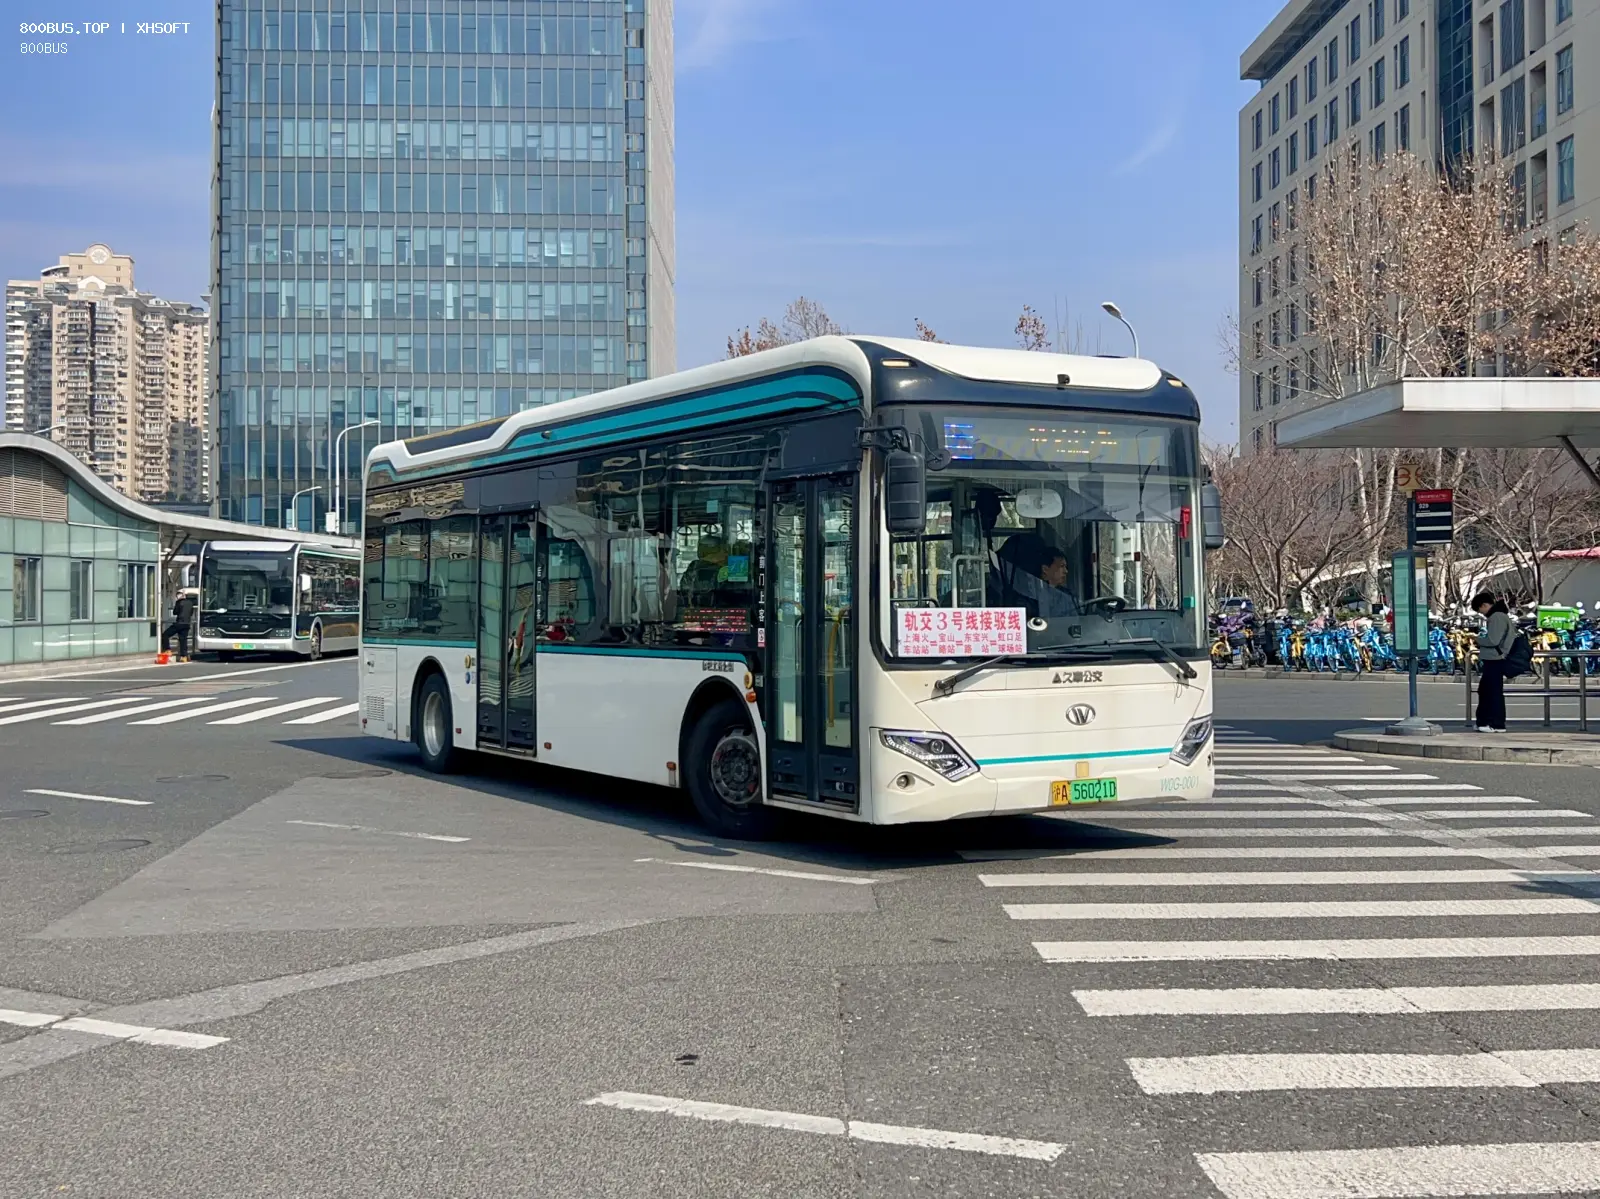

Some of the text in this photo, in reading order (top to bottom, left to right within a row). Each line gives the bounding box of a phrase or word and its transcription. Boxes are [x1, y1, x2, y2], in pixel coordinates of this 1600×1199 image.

[904, 610, 1021, 631] 轨交3号线接驳线
[903, 632, 1023, 643] 上海火 宝山 东宝兴 虹口足
[1073, 780, 1117, 800] 56021D
